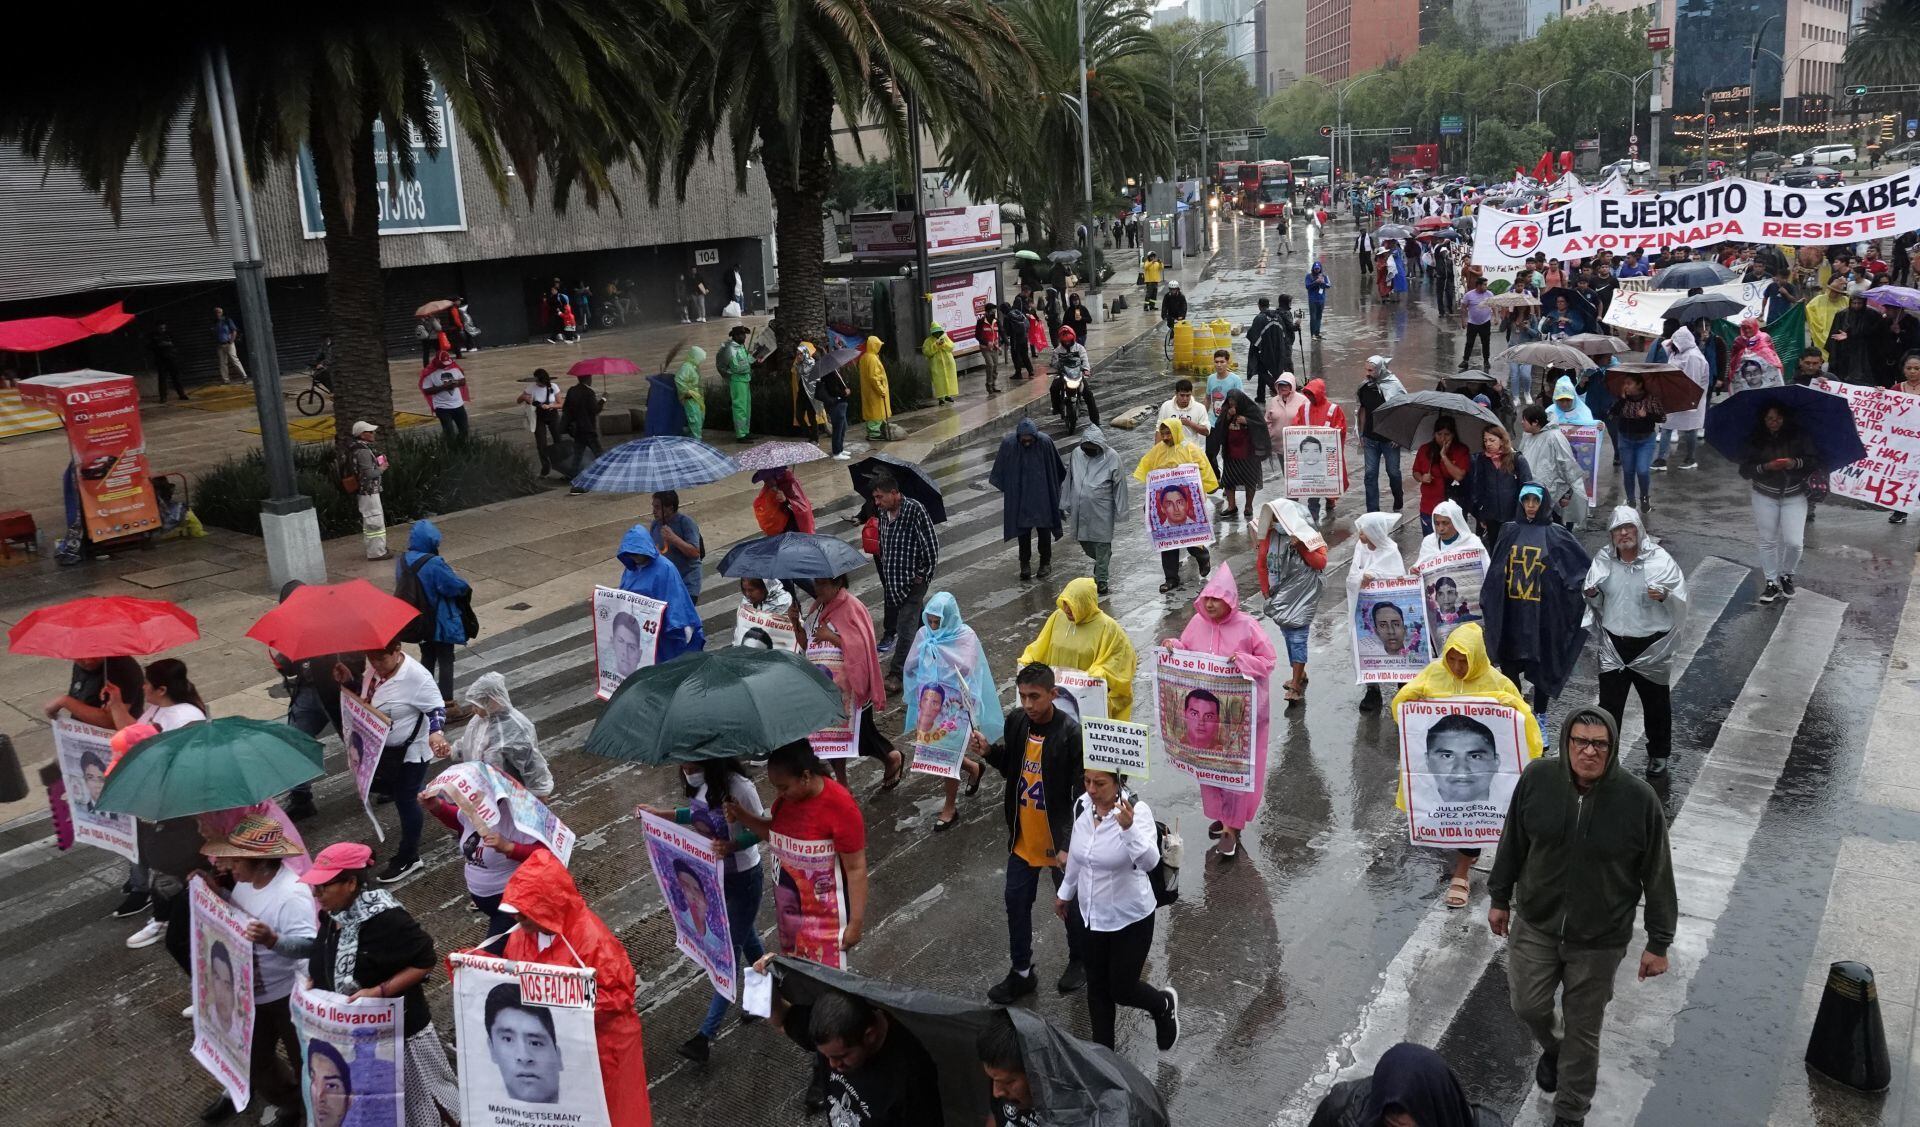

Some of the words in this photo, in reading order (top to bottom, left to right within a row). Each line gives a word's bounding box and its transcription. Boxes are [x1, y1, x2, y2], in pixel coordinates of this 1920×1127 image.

[1500, 225, 1540, 250] 43
[1547, 208, 1582, 237] EL
[1764, 190, 1807, 218] LO
[1562, 220, 1744, 253] AYOTZINAPA
[1762, 213, 1896, 239] RESISTE
[698, 250, 716, 263] 104
[1836, 384, 1848, 395] la
[1850, 397, 1892, 414] JUSTICIA
[1870, 435, 1888, 446] LA
[1876, 447, 1909, 465] HAGA
[1171, 468, 1196, 477] llevaron!
[1864, 475, 1904, 506] 43
[1443, 550, 1480, 563] llevaron!
[1376, 579, 1385, 588] lo
[1386, 578, 1419, 588] llevaron!
[642, 620, 657, 634] 43
[757, 617, 764, 625] lo
[1182, 660, 1195, 668] se
[1197, 660, 1206, 669] lo
[1208, 661, 1240, 674] llevaro
[1363, 672, 1375, 681] ¡Con
[1377, 672, 1391, 680] VIDA
[1392, 672, 1399, 680] lo
[1400, 673, 1417, 681] quere
[1435, 706, 1448, 715] se
[1450, 705, 1460, 715] lo
[1464, 704, 1512, 719] llevaron!
[84, 725, 90, 735] lo
[366, 712, 387, 735] llevaron!
[1084, 722, 1115, 732] ¡VIVOS
[1118, 725, 1128, 733] SE
[1129, 727, 1147, 737] LOS
[1089, 733, 1143, 748] LLEVARON,
[1092, 744, 1120, 754] VIVOS
[1122, 747, 1140, 757] LOS
[1088, 754, 1145, 768] QUEREMOS!
[1019, 776, 1046, 810] 24
[1428, 811, 1458, 819] LÓPEZ
[1417, 826, 1437, 837] ¡Con
[1439, 827, 1462, 837] VIDA
[1464, 827, 1473, 837] lo
[1475, 828, 1502, 838] quere
[663, 829, 672, 841] se
[673, 833, 680, 846] lo
[682, 840, 715, 864] llevaron!
[774, 838, 783, 847] lo
[520, 974, 542, 1002] NOS
[544, 975, 584, 1005] FALTAN
[584, 979, 597, 1009] 43
[305, 999, 315, 1012] se
[317, 1003, 326, 1018] lo
[329, 1007, 392, 1025] llevaron!
[488, 1104, 520, 1116] MARTÍN
[522, 1111, 582, 1122] GETSEMANY
